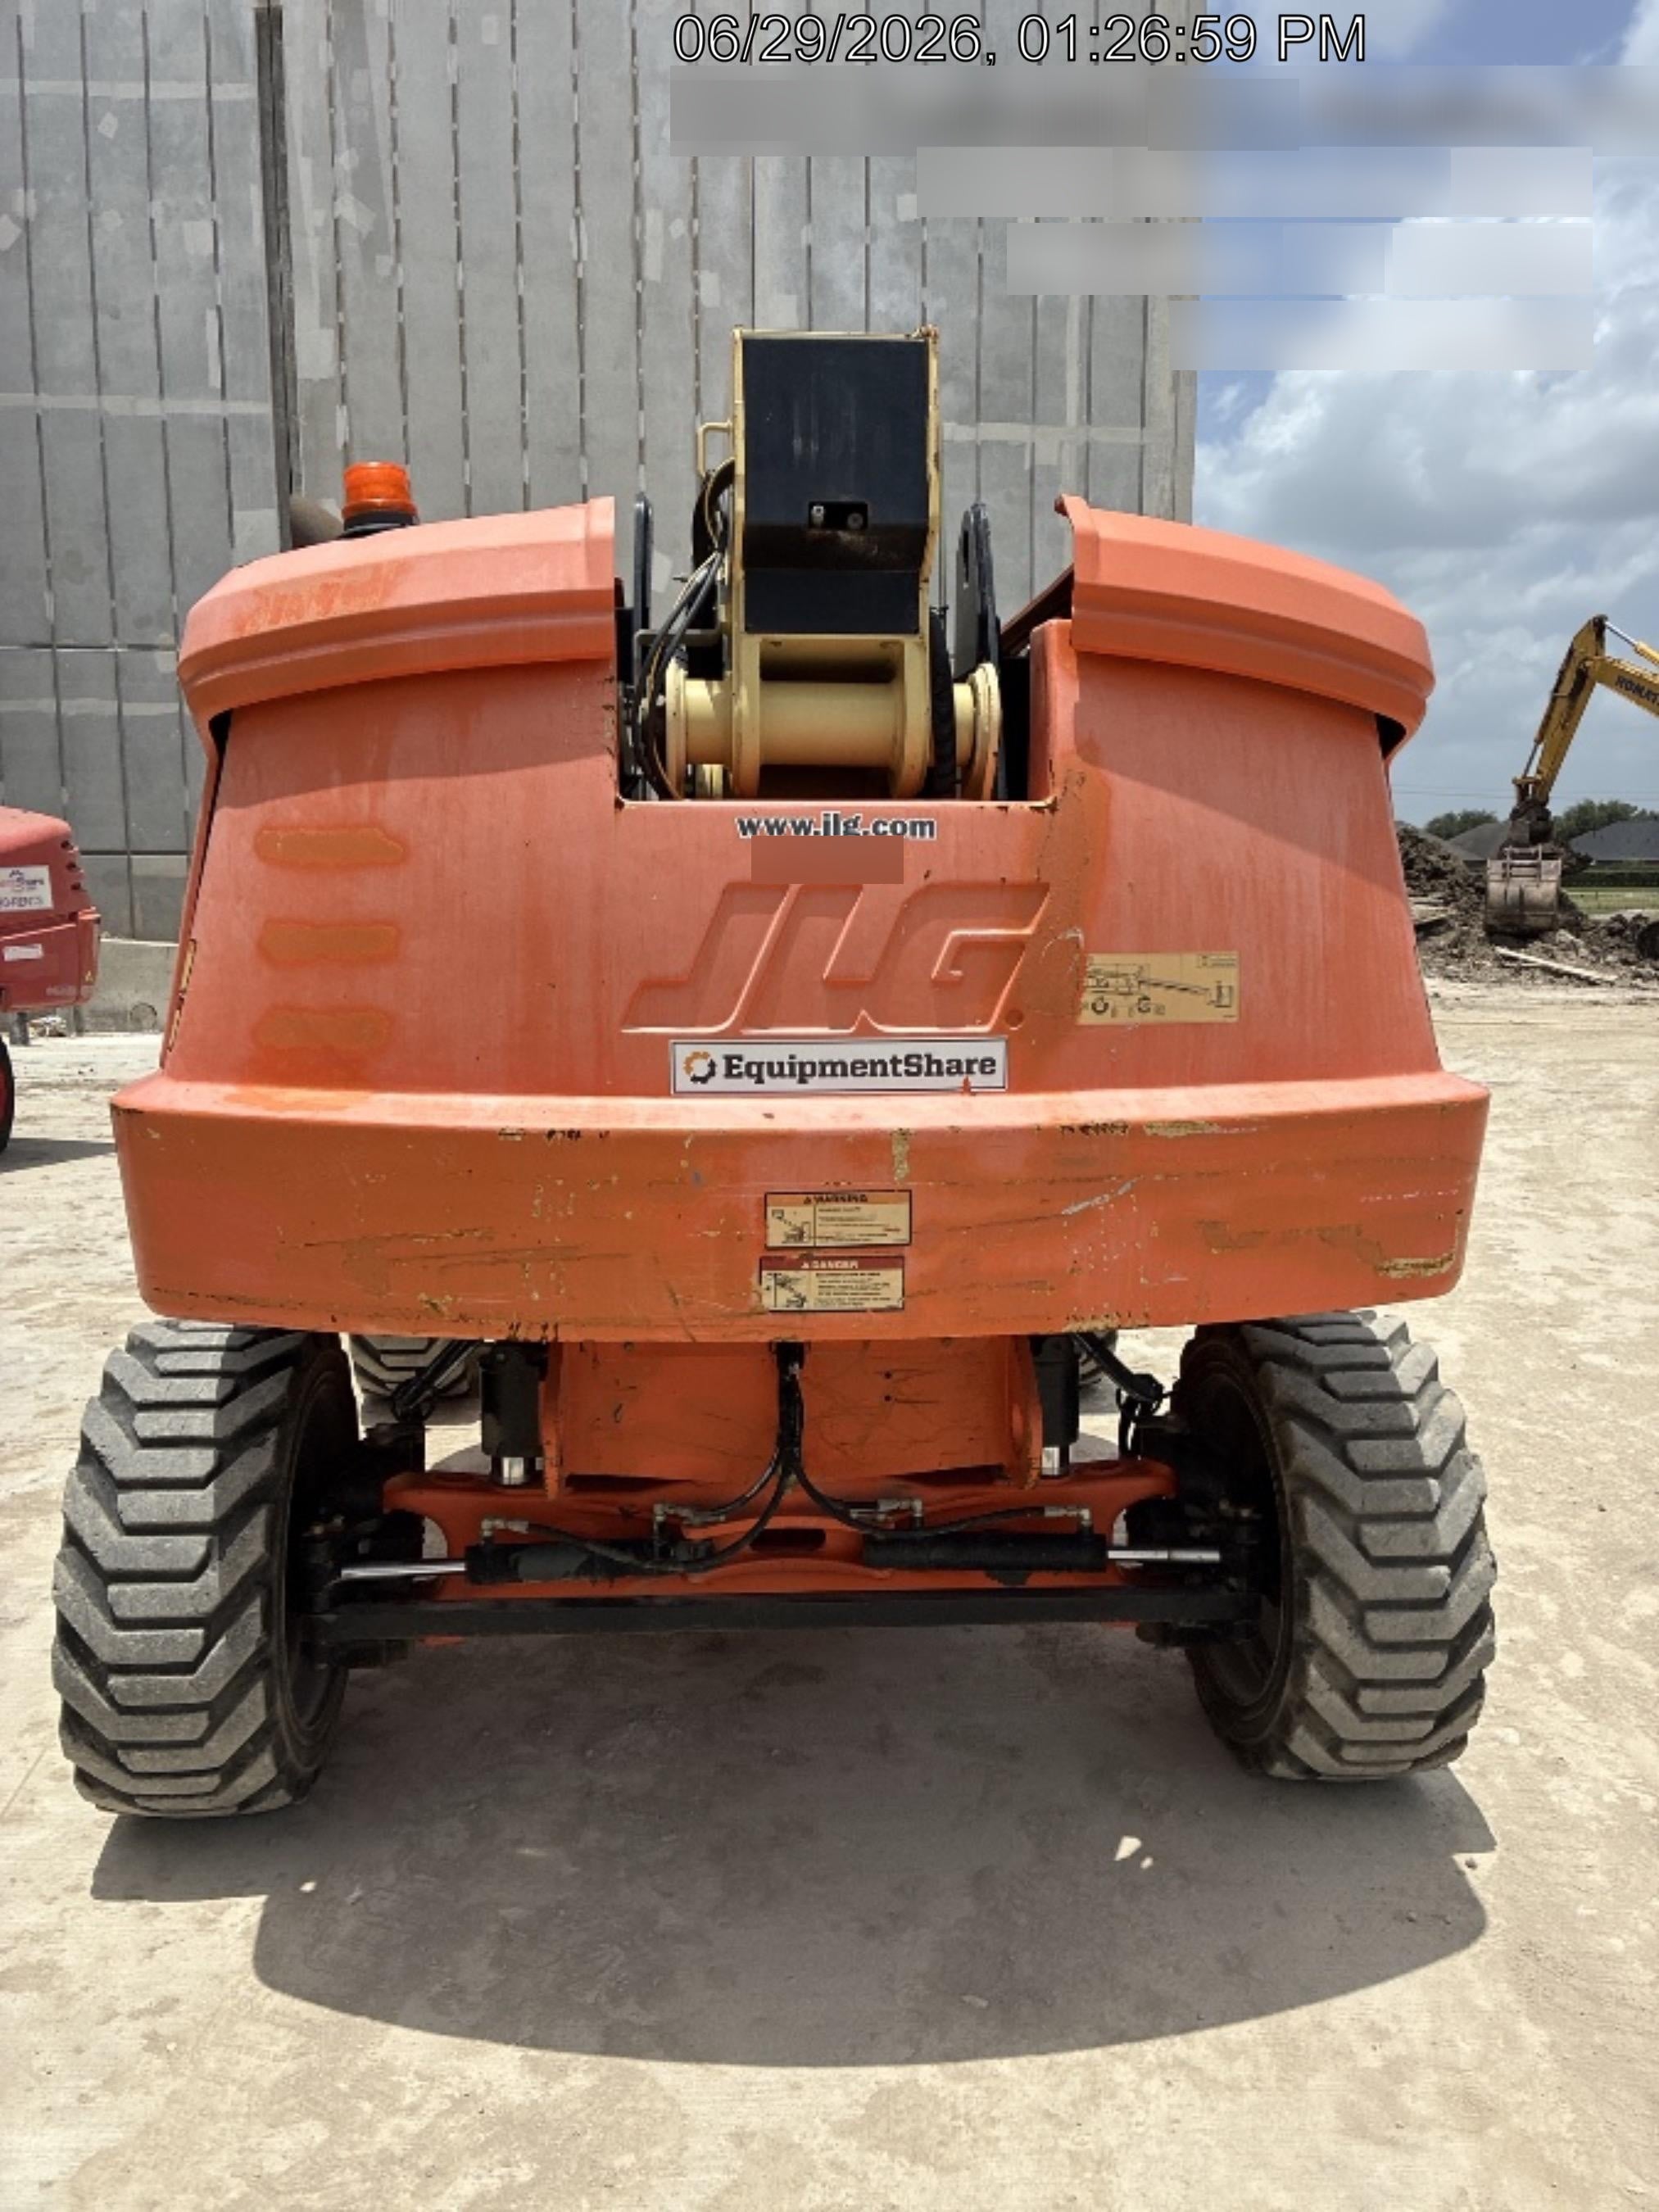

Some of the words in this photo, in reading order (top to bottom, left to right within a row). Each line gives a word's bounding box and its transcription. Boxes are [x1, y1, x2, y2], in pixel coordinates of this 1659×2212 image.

[1614, 674, 1659, 706] KOMAT
[620, 882, 1051, 1034] JLG
[723, 1054, 996, 1084] EquipmentShare
[814, 1193, 868, 1204] WARNING
[811, 1260, 859, 1269] DANGER
